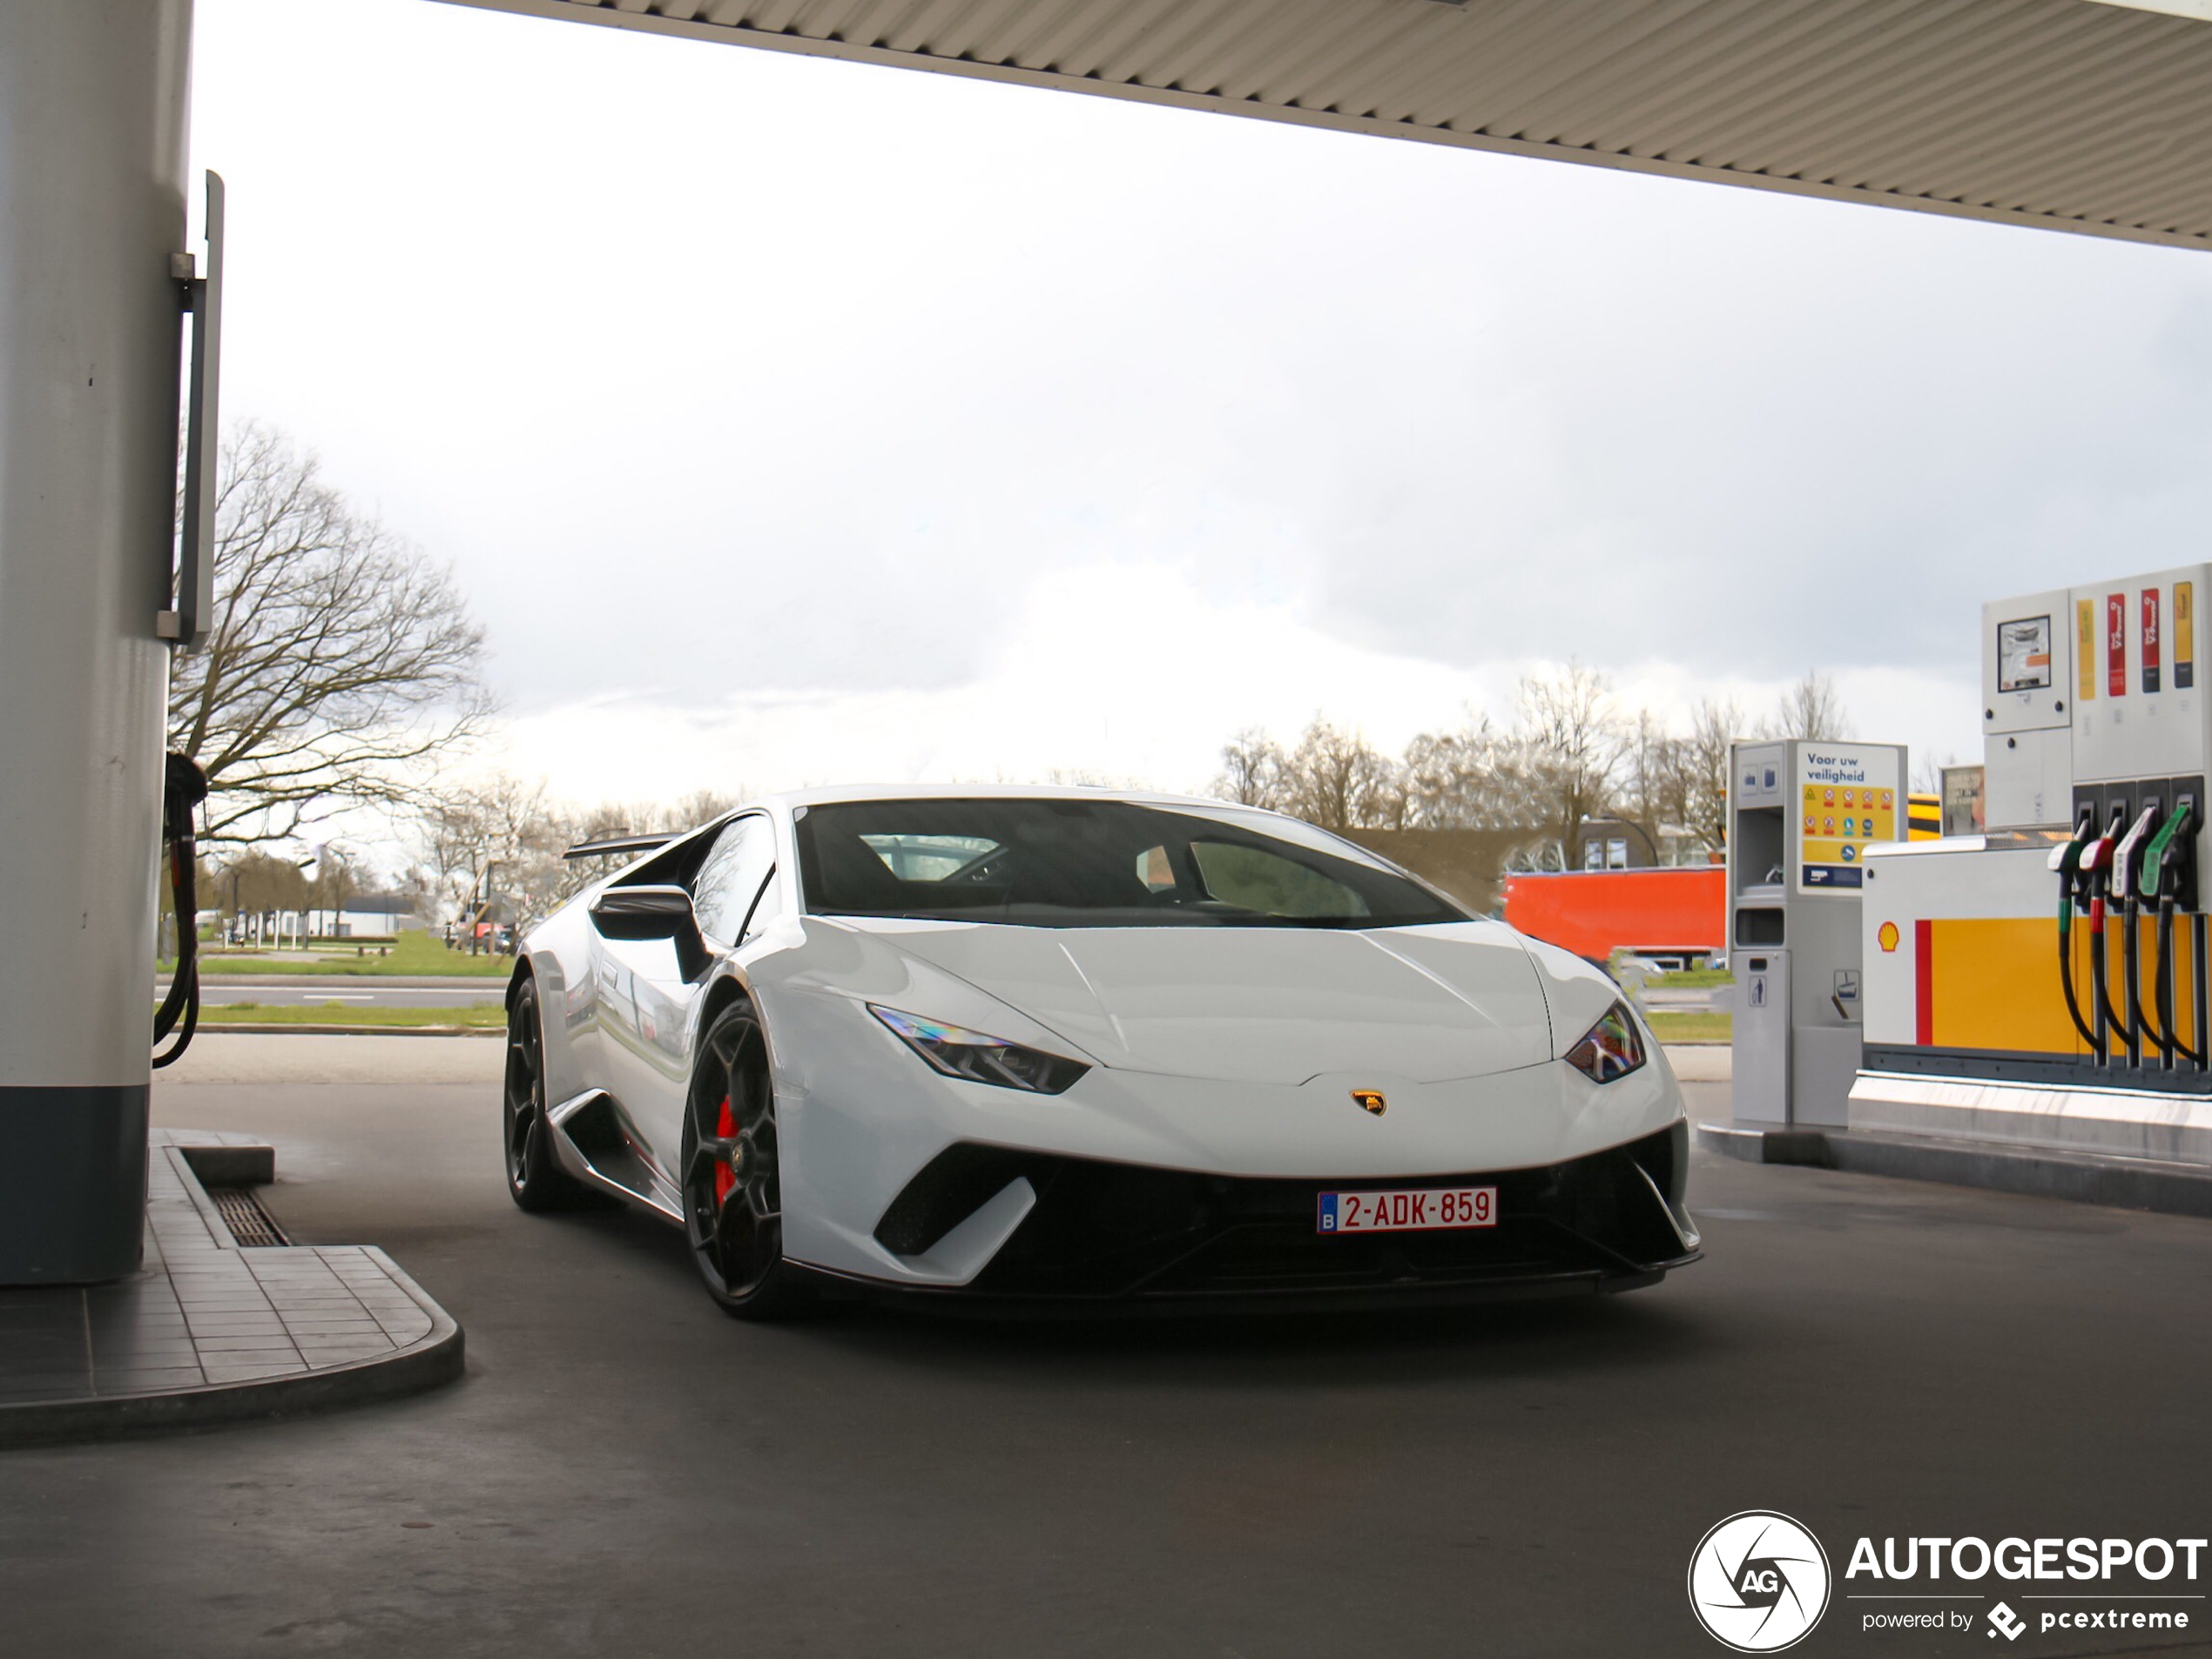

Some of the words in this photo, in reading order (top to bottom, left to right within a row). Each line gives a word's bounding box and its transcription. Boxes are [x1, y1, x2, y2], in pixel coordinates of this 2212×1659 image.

[1807, 753, 1837, 765] Voor
[1840, 758, 1858, 766] uw
[1807, 769, 1865, 784] veiligheid
[1345, 1191, 1490, 1227] 2-ADK-859
[1323, 1214, 1334, 1229] B
